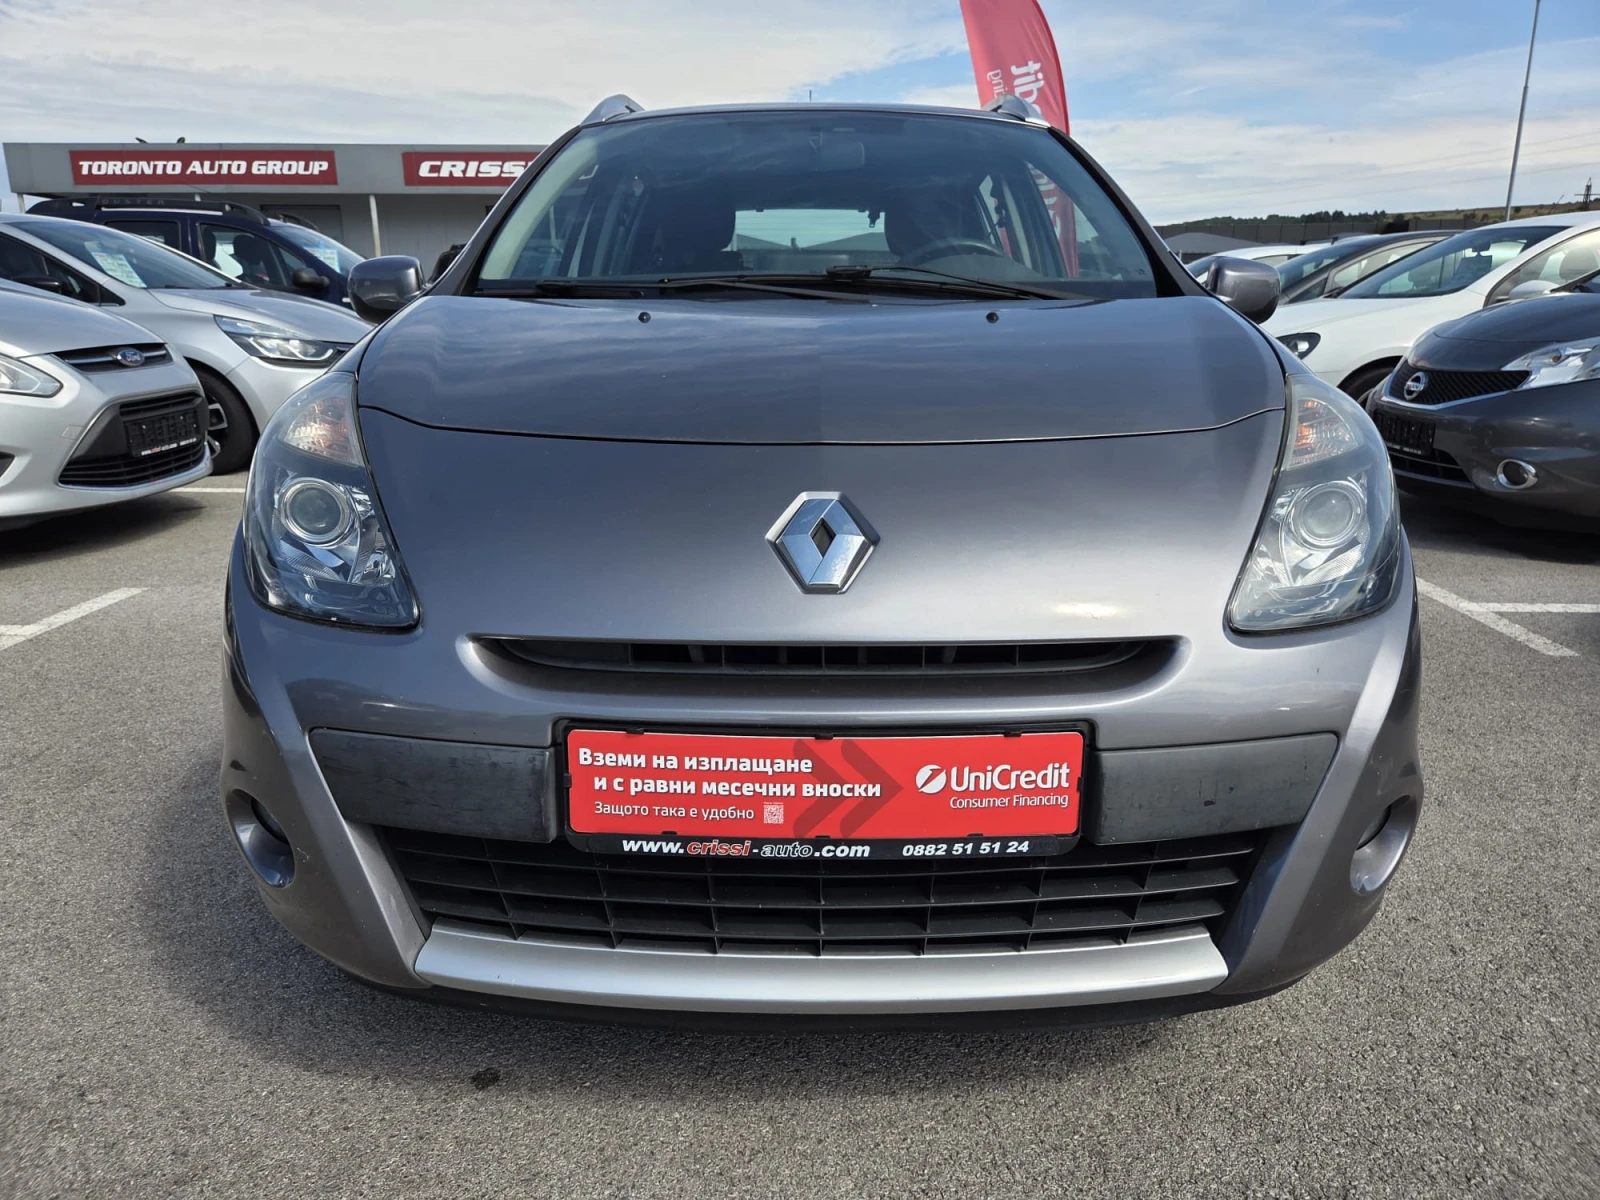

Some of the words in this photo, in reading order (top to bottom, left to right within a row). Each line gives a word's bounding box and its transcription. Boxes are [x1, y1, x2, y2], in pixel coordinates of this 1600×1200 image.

[78, 160, 182, 175] TORONTO
[186, 160, 247, 175] AUTO
[252, 160, 329, 175] GROUP
[418, 160, 532, 177] CRISS
[579, 747, 646, 768] Вземи
[652, 755, 679, 769] на
[684, 756, 813, 776] изплащане
[593, 776, 607, 791] и
[612, 776, 625, 792] с
[629, 778, 696, 796] равни
[702, 781, 796, 797] месечни
[802, 782, 881, 798] вноски
[950, 762, 1071, 792] UniCredit
[594, 801, 649, 817] Защото
[652, 806, 686, 818] така
[689, 807, 698, 818] е
[701, 806, 755, 821] удобно
[950, 796, 1010, 809] Consumer
[1013, 793, 1069, 808] Financing
[622, 838, 871, 858] www.crissi-auto.com
[902, 843, 948, 857] 0882
[951, 842, 974, 856] 51
[979, 841, 1001, 855] 51
[1006, 840, 1030, 854] 24
